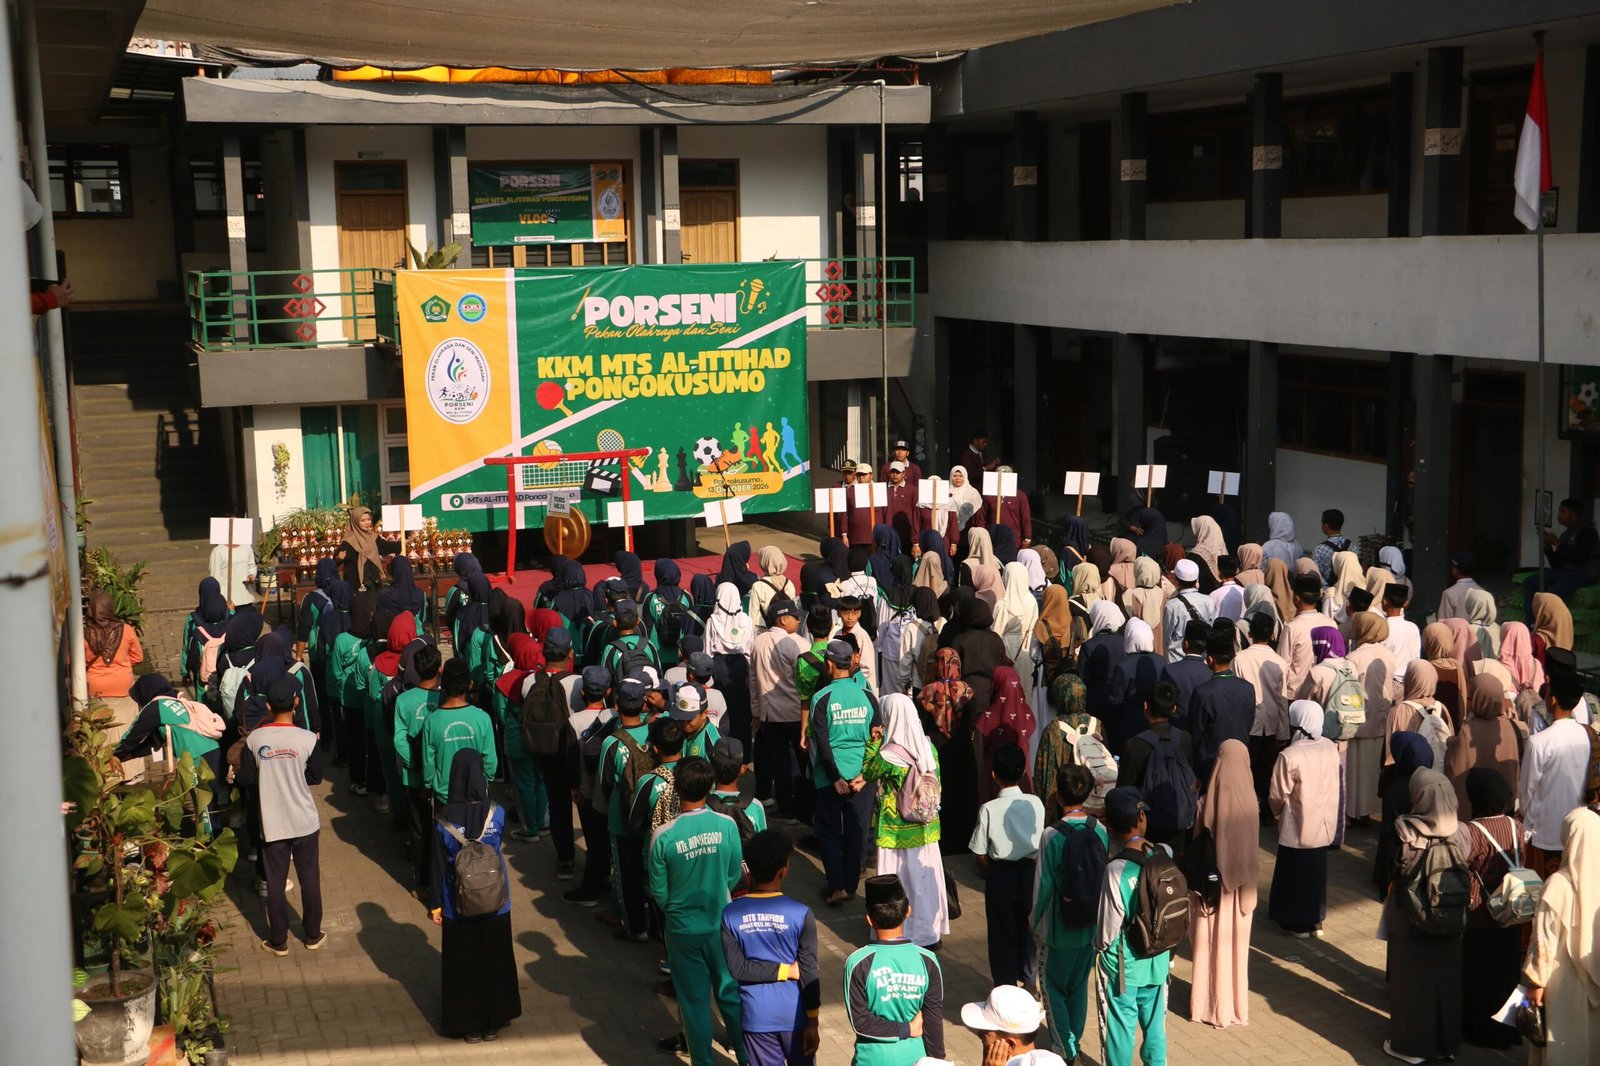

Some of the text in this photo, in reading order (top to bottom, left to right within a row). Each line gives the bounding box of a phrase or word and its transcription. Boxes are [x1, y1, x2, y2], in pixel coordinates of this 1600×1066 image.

[500, 174, 560, 188] PORSENI
[584, 292, 737, 327] PORSENI
[584, 322, 741, 342] Pekan Olahraga dan Seni
[537, 348, 791, 378] KKM MTS AL-ITTIHAD
[566, 370, 766, 401] PONCOKUSUMO
